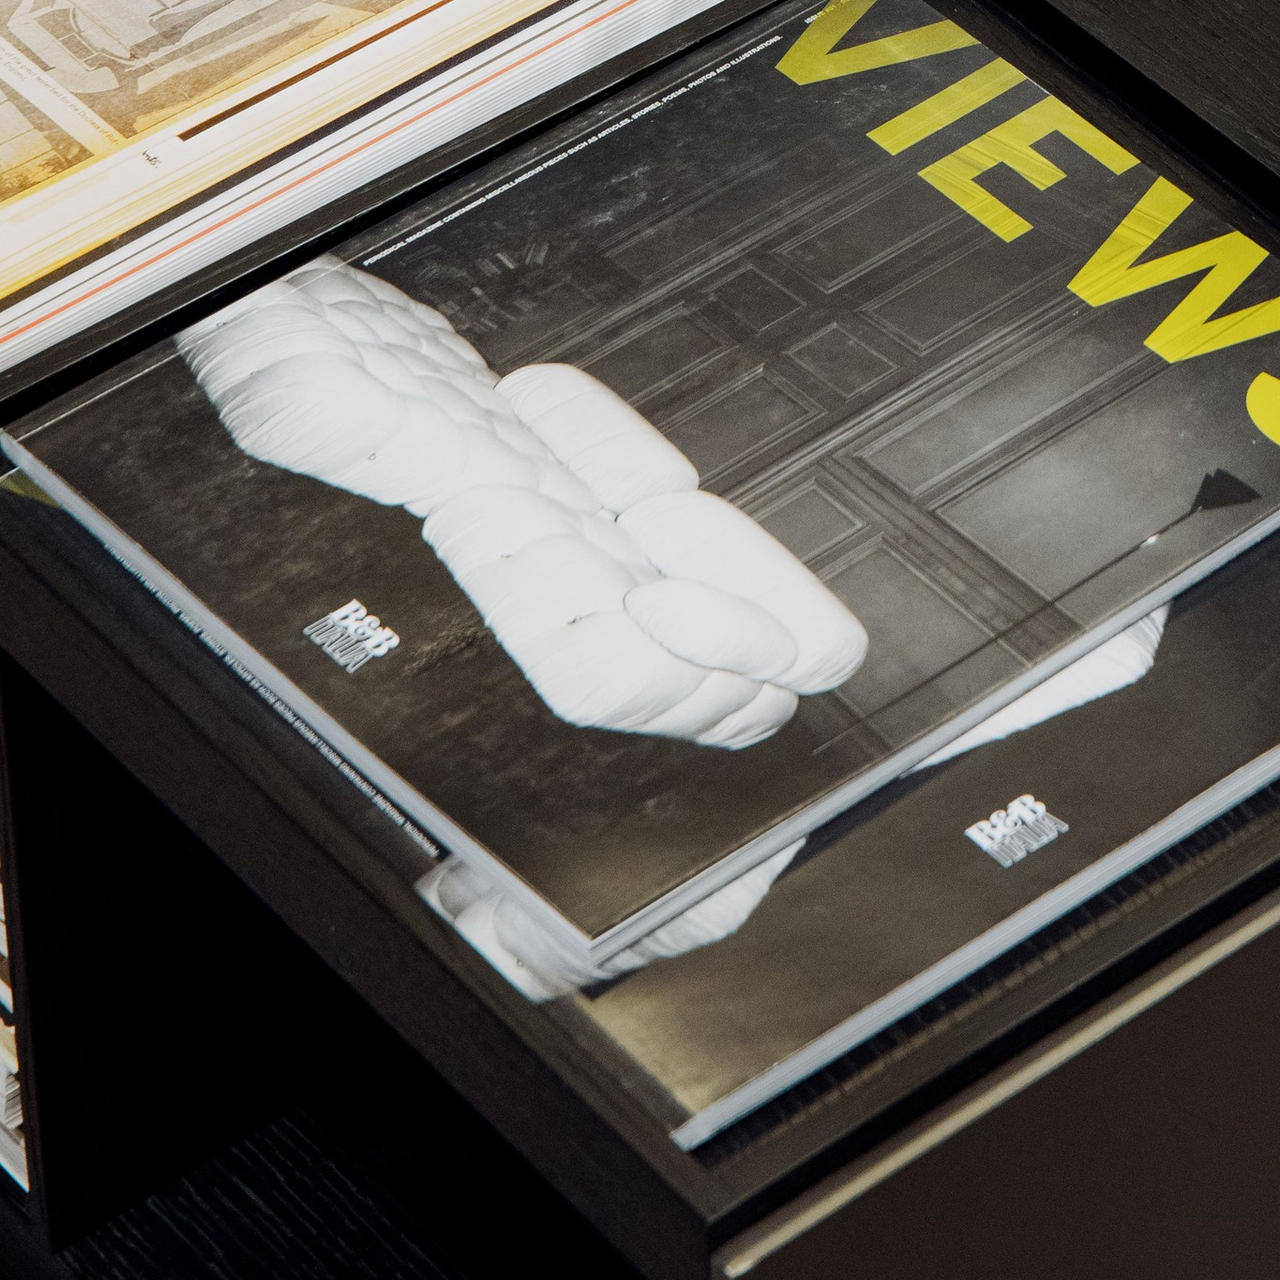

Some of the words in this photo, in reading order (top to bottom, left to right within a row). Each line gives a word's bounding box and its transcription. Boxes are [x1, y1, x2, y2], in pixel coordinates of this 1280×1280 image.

[362, 238, 407, 267] PERIODICAL
[405, 219, 444, 244] MAGAZINE
[442, 195, 486, 224] CONTAINING
[484, 164, 544, 200] MISCELLANEOUS
[541, 150, 568, 169] PIECES
[568, 140, 588, 154] SUCH
[587, 134, 598, 144] AS
[596, 115, 633, 139] ARTICLES,
[631, 99, 663, 120] STORIES,
[661, 84, 690, 104] POEMS,
[687, 70, 717, 89] PHOTOS
[715, 61, 731, 74] AND
[729, 32, 784, 66] ILLUSTRATIONS.
[302, 613, 376, 674] ITALIA
[329, 598, 400, 658] B&B
[963, 793, 1047, 853] B&B
[985, 812, 1070, 869] ITALIA
